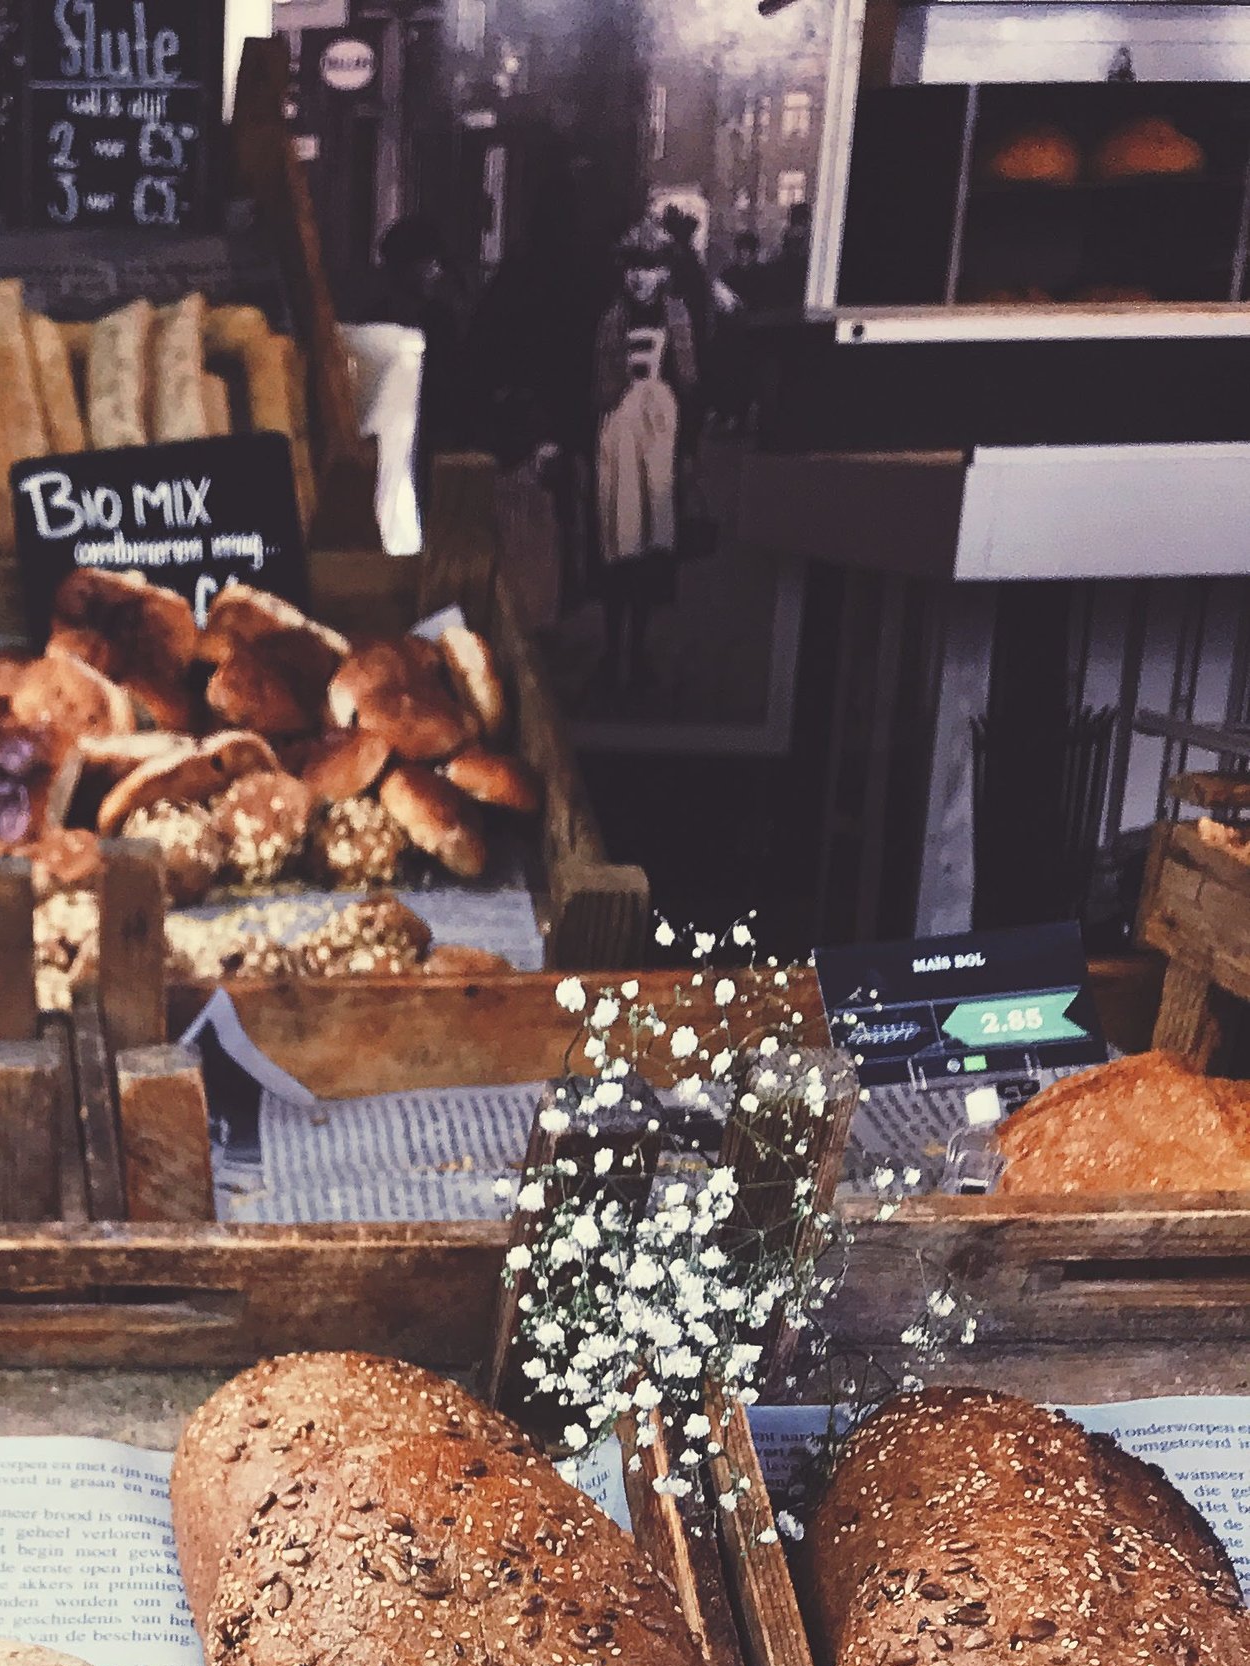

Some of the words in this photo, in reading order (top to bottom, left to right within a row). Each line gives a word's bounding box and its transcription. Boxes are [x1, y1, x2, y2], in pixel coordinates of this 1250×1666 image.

[131, 475, 212, 528] MIX
[1125, 1422, 1235, 1438] onderworpen
[1131, 1438, 1232, 1453] omgetoverd
[110, 1465, 142, 1480] zijn
[1175, 1470, 1245, 1482] wanneer
[45, 1475, 63, 1486] in
[70, 1477, 116, 1490] graan
[122, 1482, 143, 1493] en
[1193, 1485, 1222, 1498] die
[43, 1508, 93, 1522] brood
[98, 1511, 112, 1522] is
[15, 1526, 71, 1541] geheel
[82, 1527, 152, 1541] verloren
[17, 1543, 65, 1558] begin
[75, 1546, 118, 1558] moet
[22, 1564, 74, 1575] eerste
[79, 1565, 122, 1577] open
[19, 1578, 74, 1591] akkers
[82, 1580, 99, 1591] in
[53, 1596, 119, 1609] worden
[133, 1598, 162, 1609] om
[12, 1612, 123, 1629] geschiedenis
[131, 1615, 162, 1626] van
[65, 1629, 87, 1643] de
[92, 1629, 196, 1648] beschaving.
